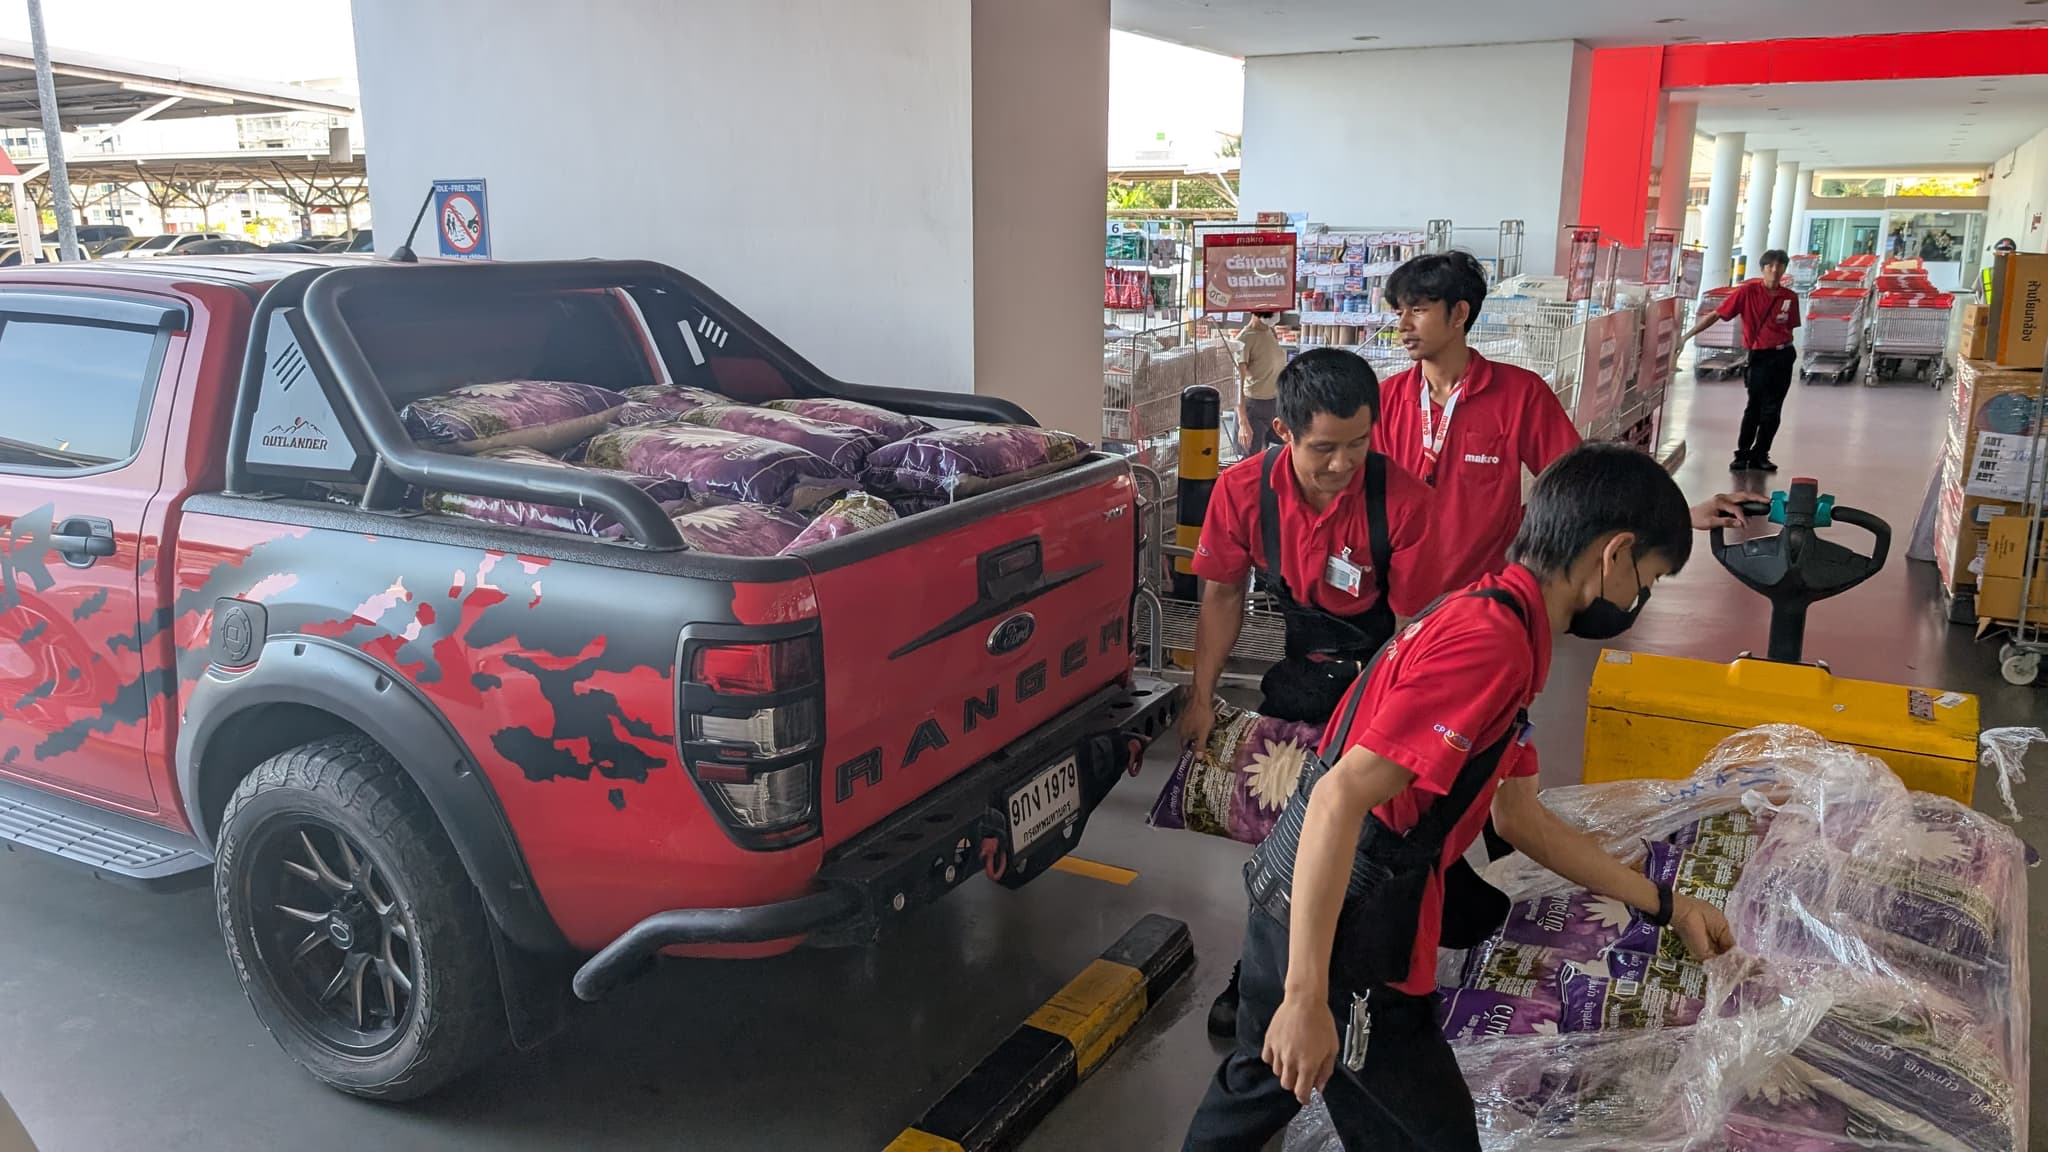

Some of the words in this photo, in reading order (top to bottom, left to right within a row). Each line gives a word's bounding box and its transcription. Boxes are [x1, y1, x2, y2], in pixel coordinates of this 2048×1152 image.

[1111, 223, 1120, 234] 6
[1236, 235, 1264, 244] makro
[2021, 280, 2041, 343] ห้ามโยนกล่อง
[1421, 409, 1431, 437] makro
[1436, 415, 1449, 441] makro
[262, 435, 328, 451] OUTLANDER
[1464, 454, 1500, 465] makro
[1044, 762, 1076, 805] 1979
[1023, 800, 1072, 842] กรุงเทพมหานคร
